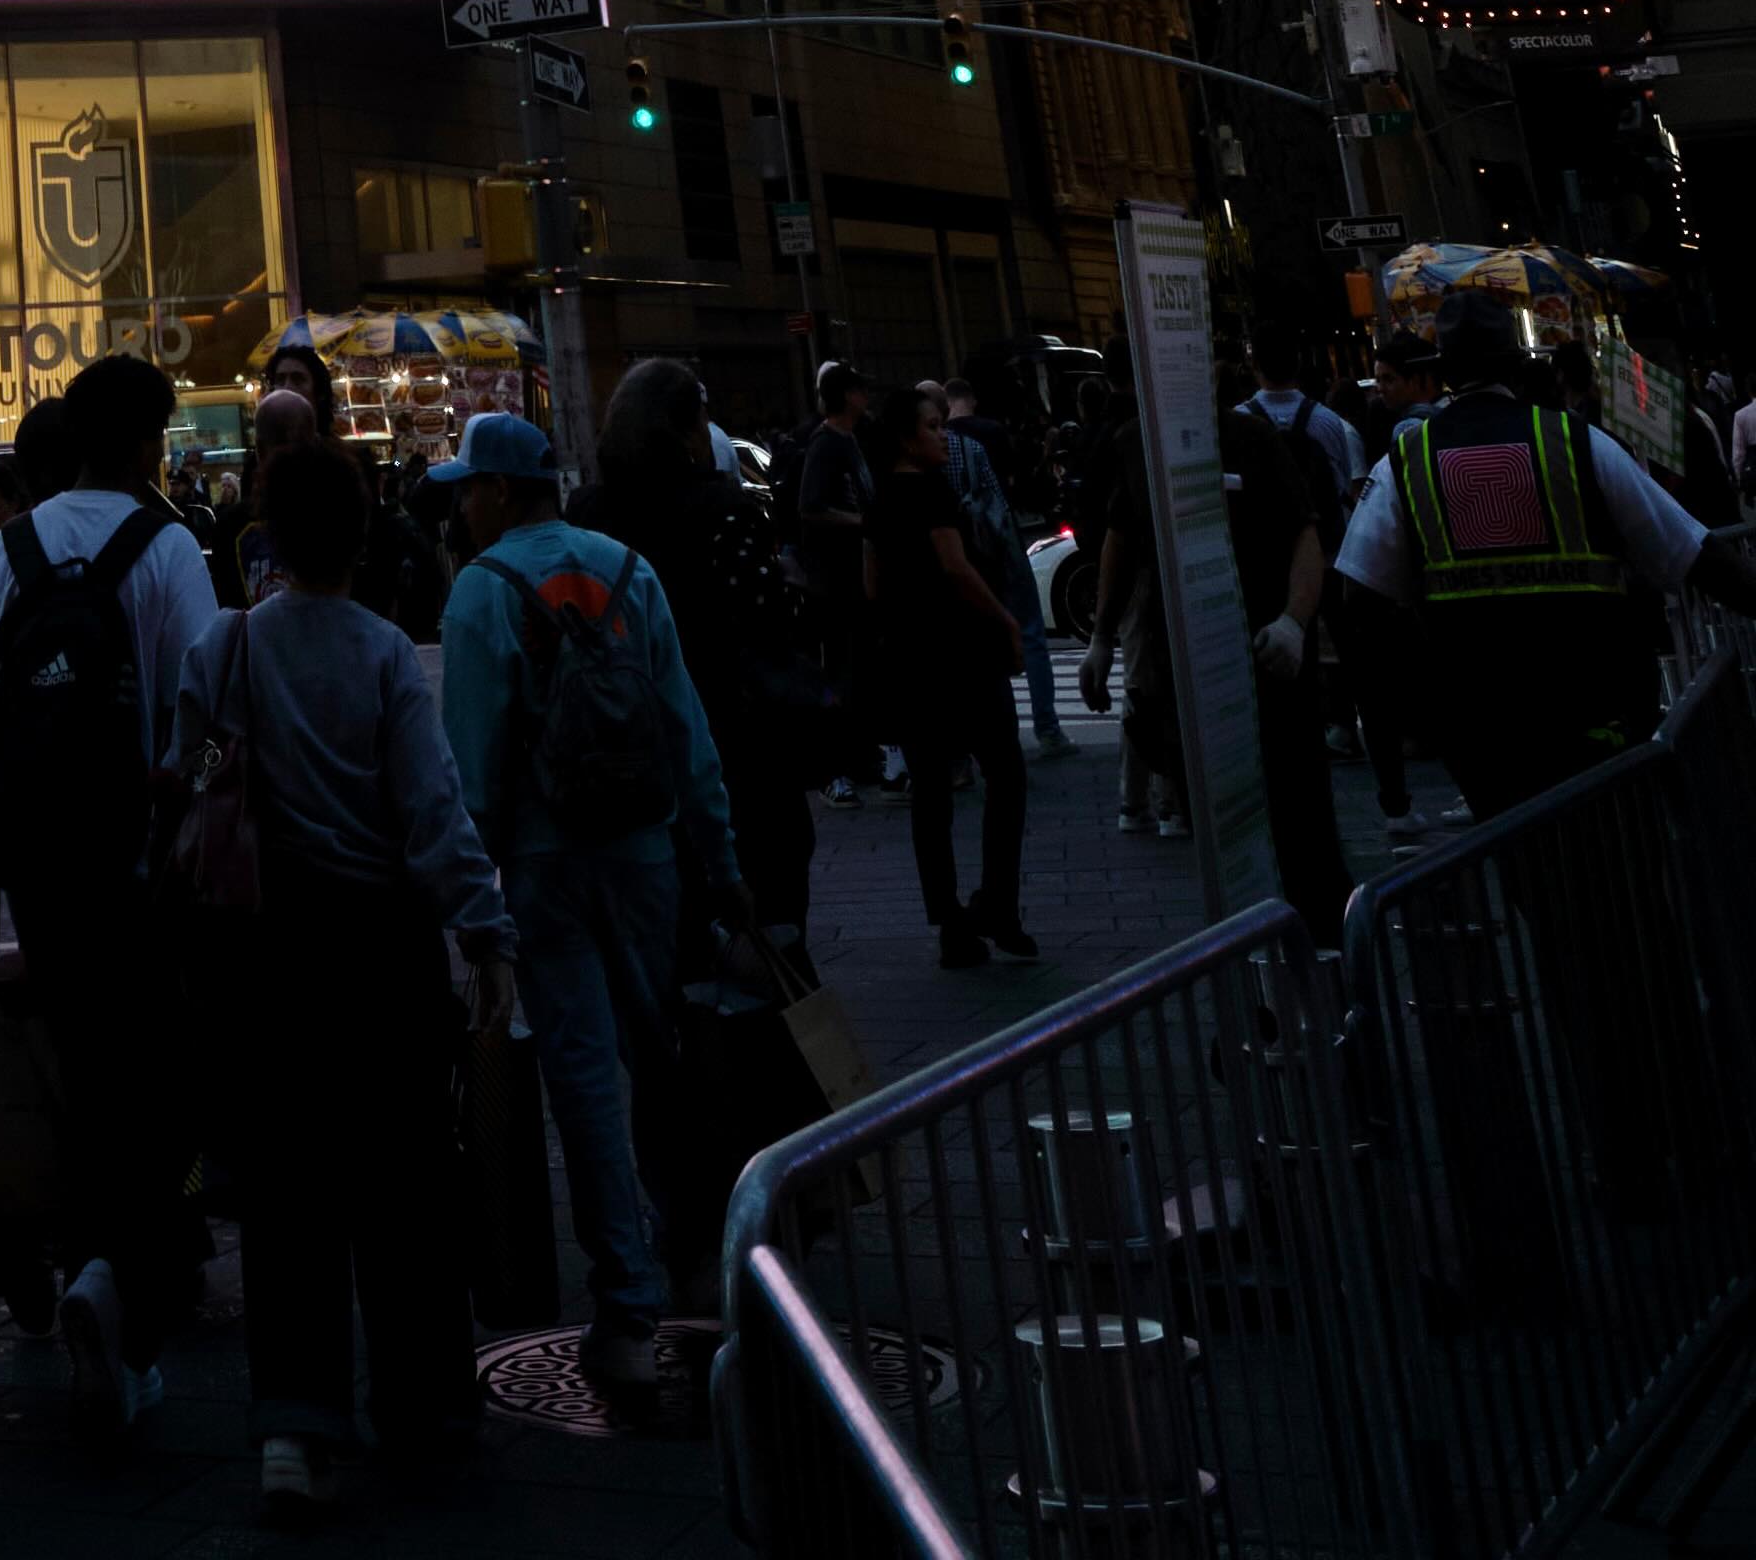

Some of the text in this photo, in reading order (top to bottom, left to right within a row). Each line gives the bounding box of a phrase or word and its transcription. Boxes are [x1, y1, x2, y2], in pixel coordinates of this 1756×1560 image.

[468, 0, 510, 26] ONE
[1509, 33, 1594, 49] SPECTACOLOR
[1333, 224, 1394, 239] ONE WAY
[1501, 563, 1590, 584] SQUARE
